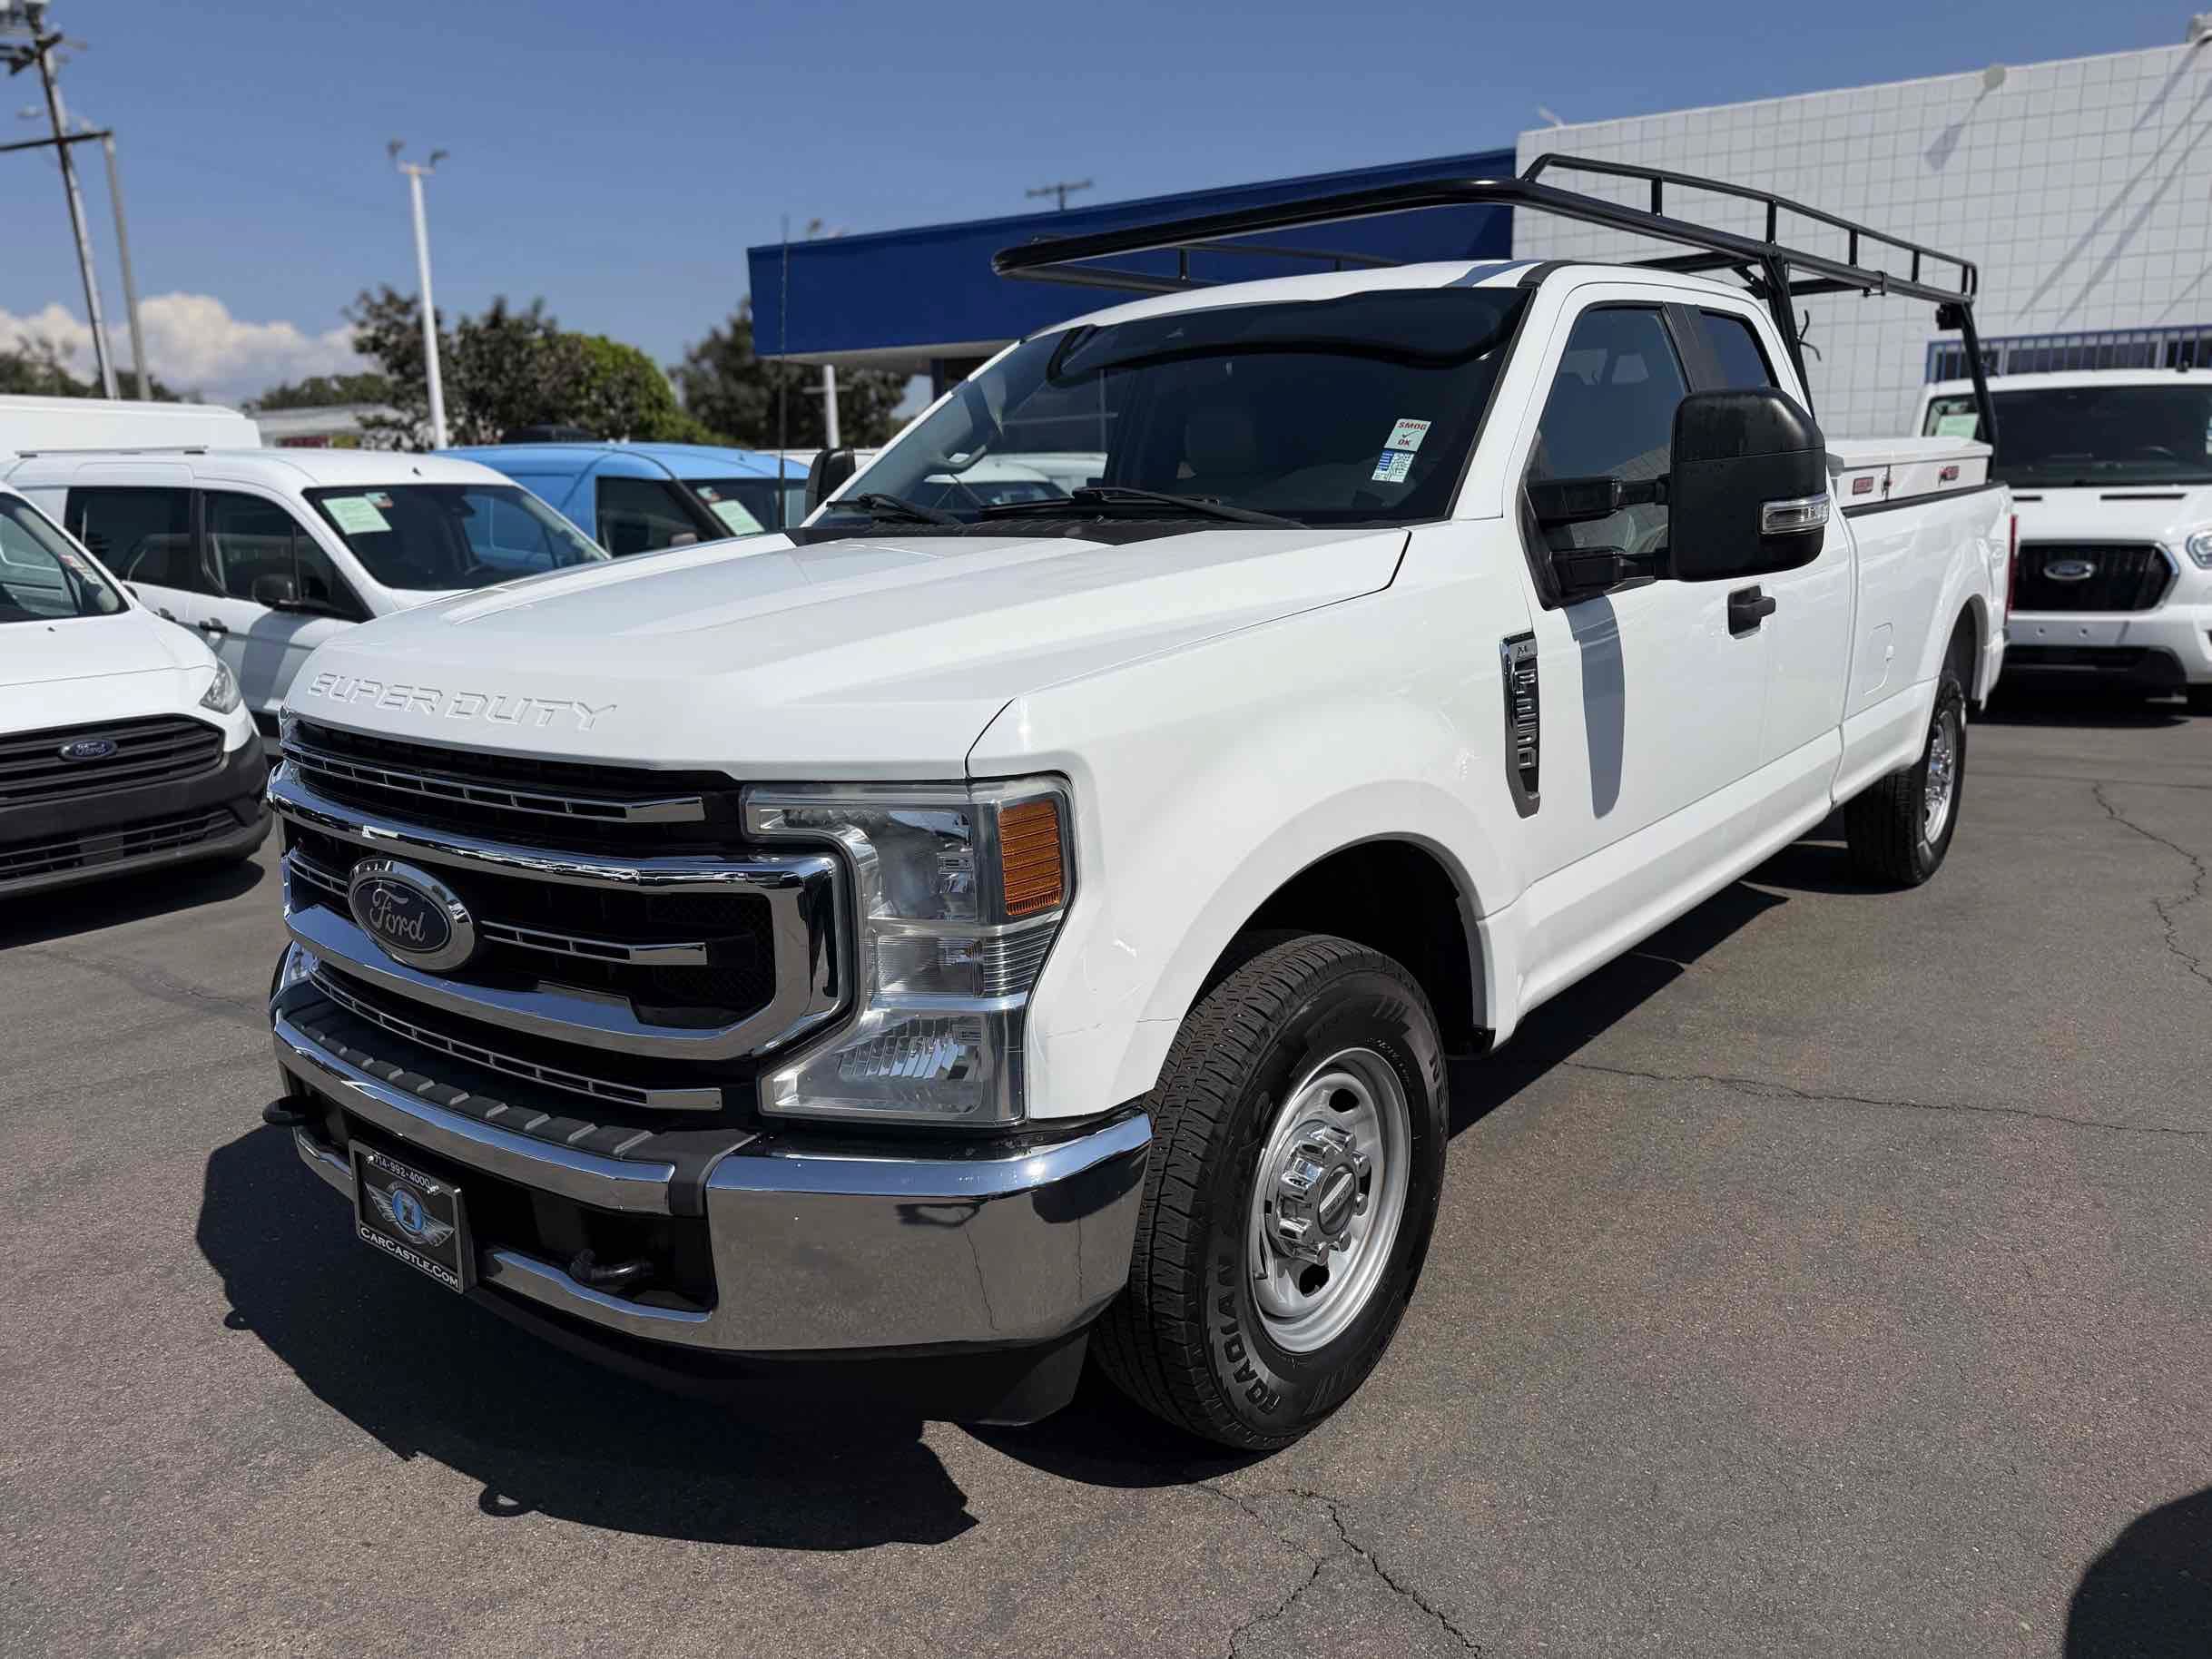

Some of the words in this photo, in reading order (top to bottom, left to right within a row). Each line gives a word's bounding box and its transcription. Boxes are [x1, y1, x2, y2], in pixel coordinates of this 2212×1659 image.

[1398, 421, 1427, 430] SMOG
[1397, 438, 1411, 447] OK
[306, 672, 444, 716] SUPER
[445, 691, 618, 732] DUTY
[369, 887, 427, 943] Ford
